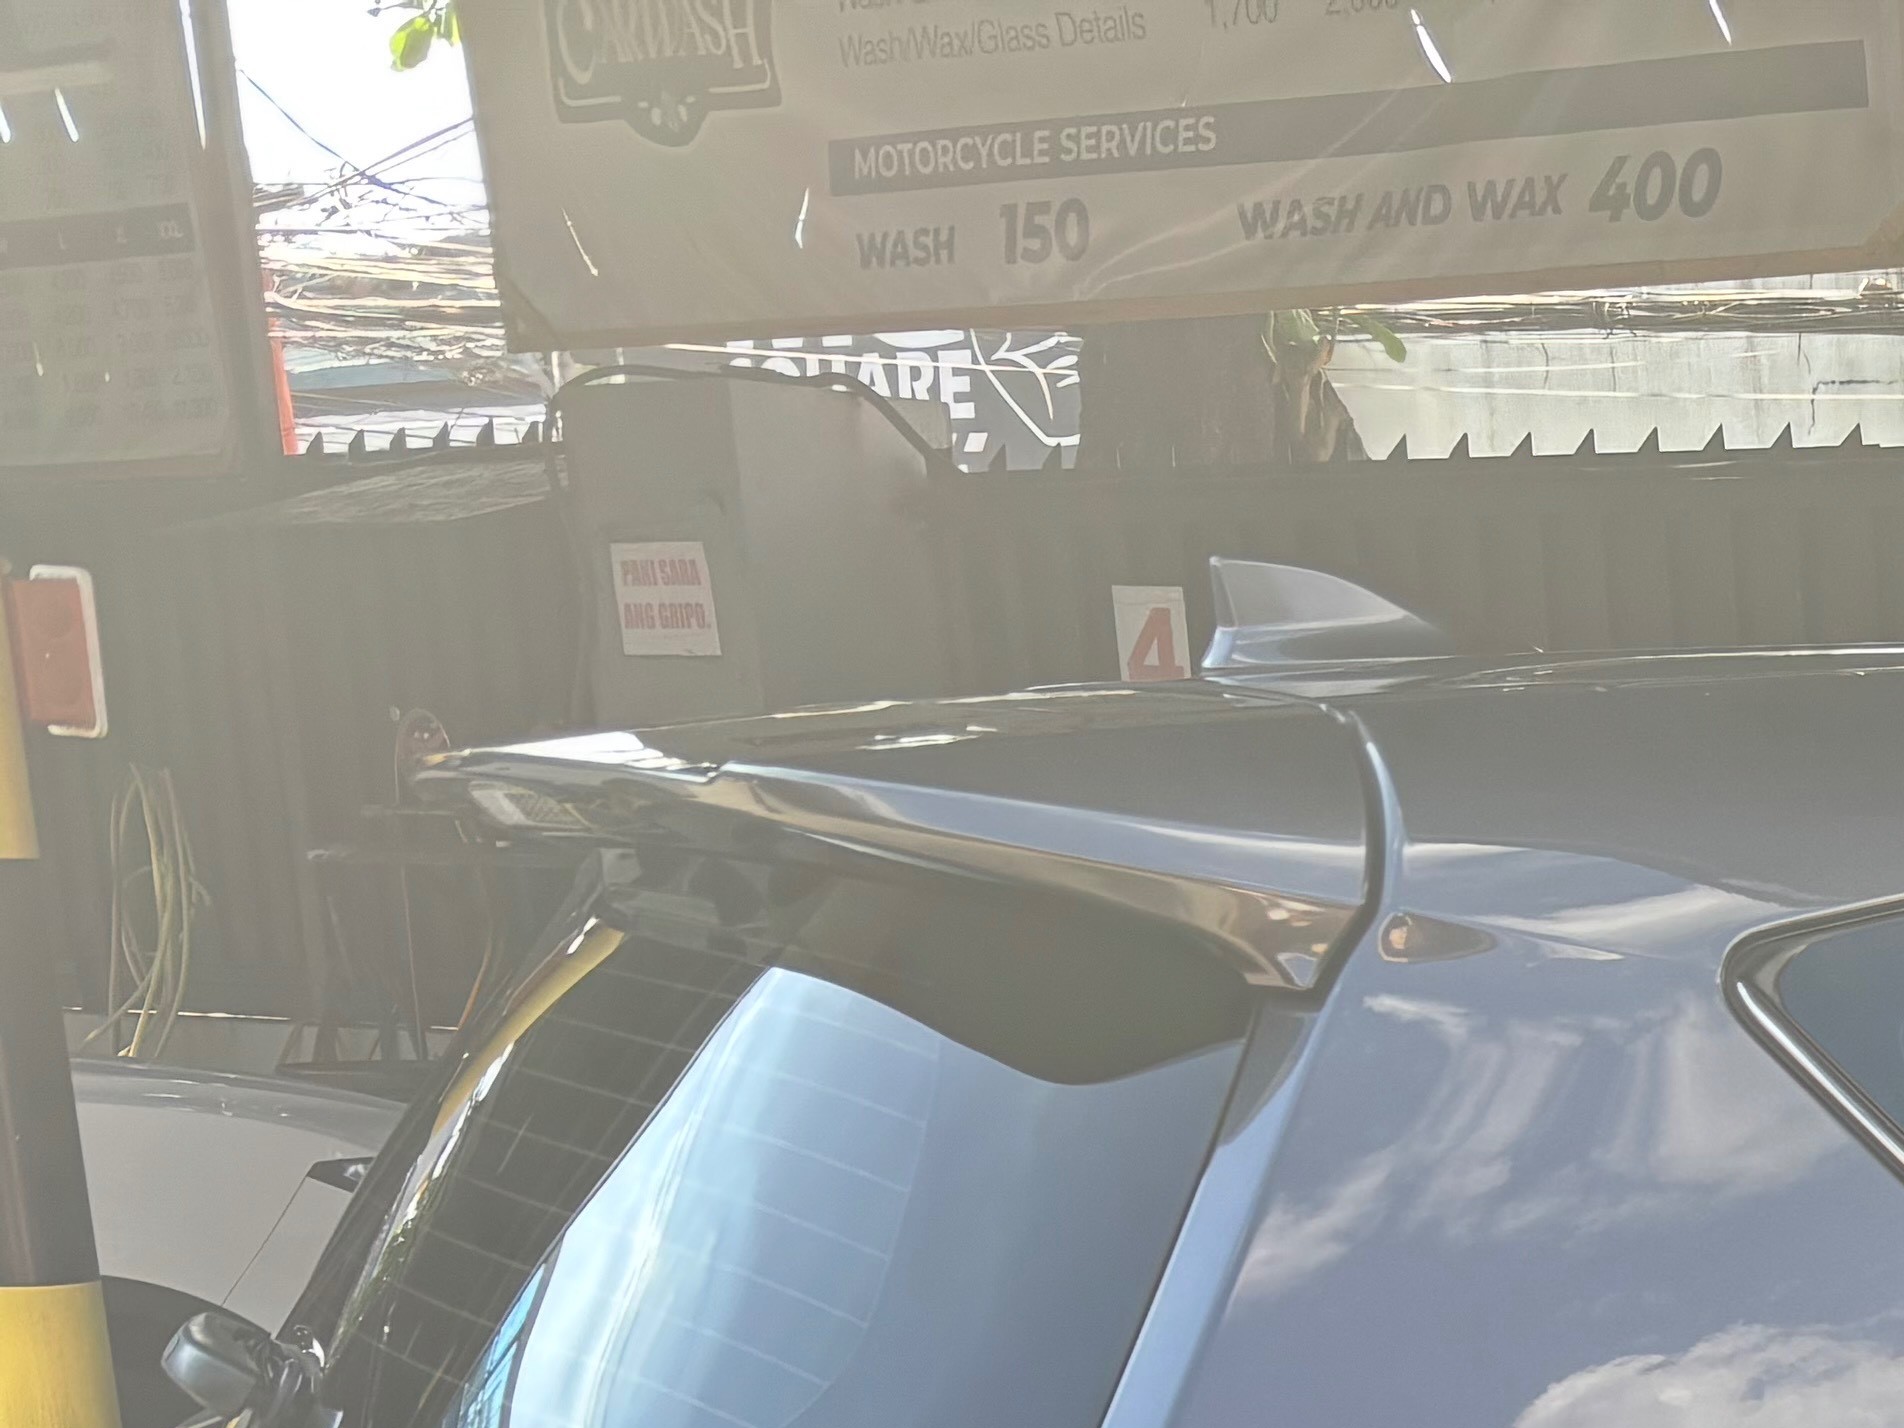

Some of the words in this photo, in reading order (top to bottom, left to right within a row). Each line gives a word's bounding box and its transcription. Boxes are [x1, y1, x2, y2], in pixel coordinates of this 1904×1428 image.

[838, 18, 1051, 67] Wash/Wax/Glass
[1054, 5, 1147, 47] Details
[853, 130, 1050, 180] MOTORCYCLE
[1059, 116, 1217, 162] SERVICES
[1236, 194, 1363, 242] WASH
[1368, 182, 1452, 230] AND
[1466, 171, 1569, 224] WAX
[1588, 147, 1724, 222] 400
[855, 225, 957, 270] WASH
[999, 198, 1090, 266] 150
[623, 602, 656, 629] ANG
[1127, 606, 1184, 680] 4
